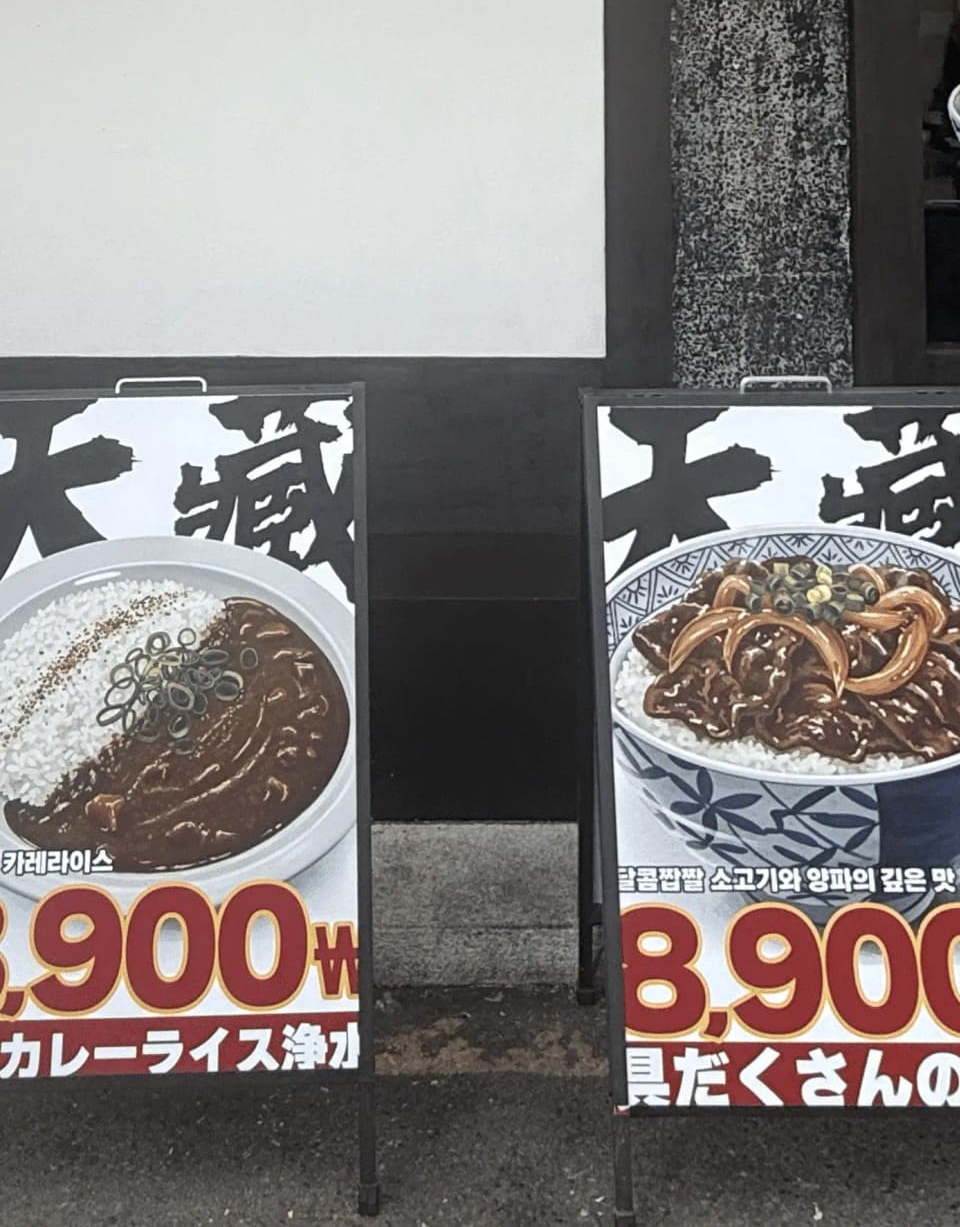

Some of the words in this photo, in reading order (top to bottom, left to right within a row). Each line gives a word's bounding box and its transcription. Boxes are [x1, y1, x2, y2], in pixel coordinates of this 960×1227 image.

[1, 849, 115, 876] 카레라이스
[709, 866, 802, 893] 소고기와
[806, 866, 877, 894] 양파의
[879, 866, 929, 894] 깊은
[930, 866, 957, 894] 맛
[0, 878, 360, 1021] ,900₩
